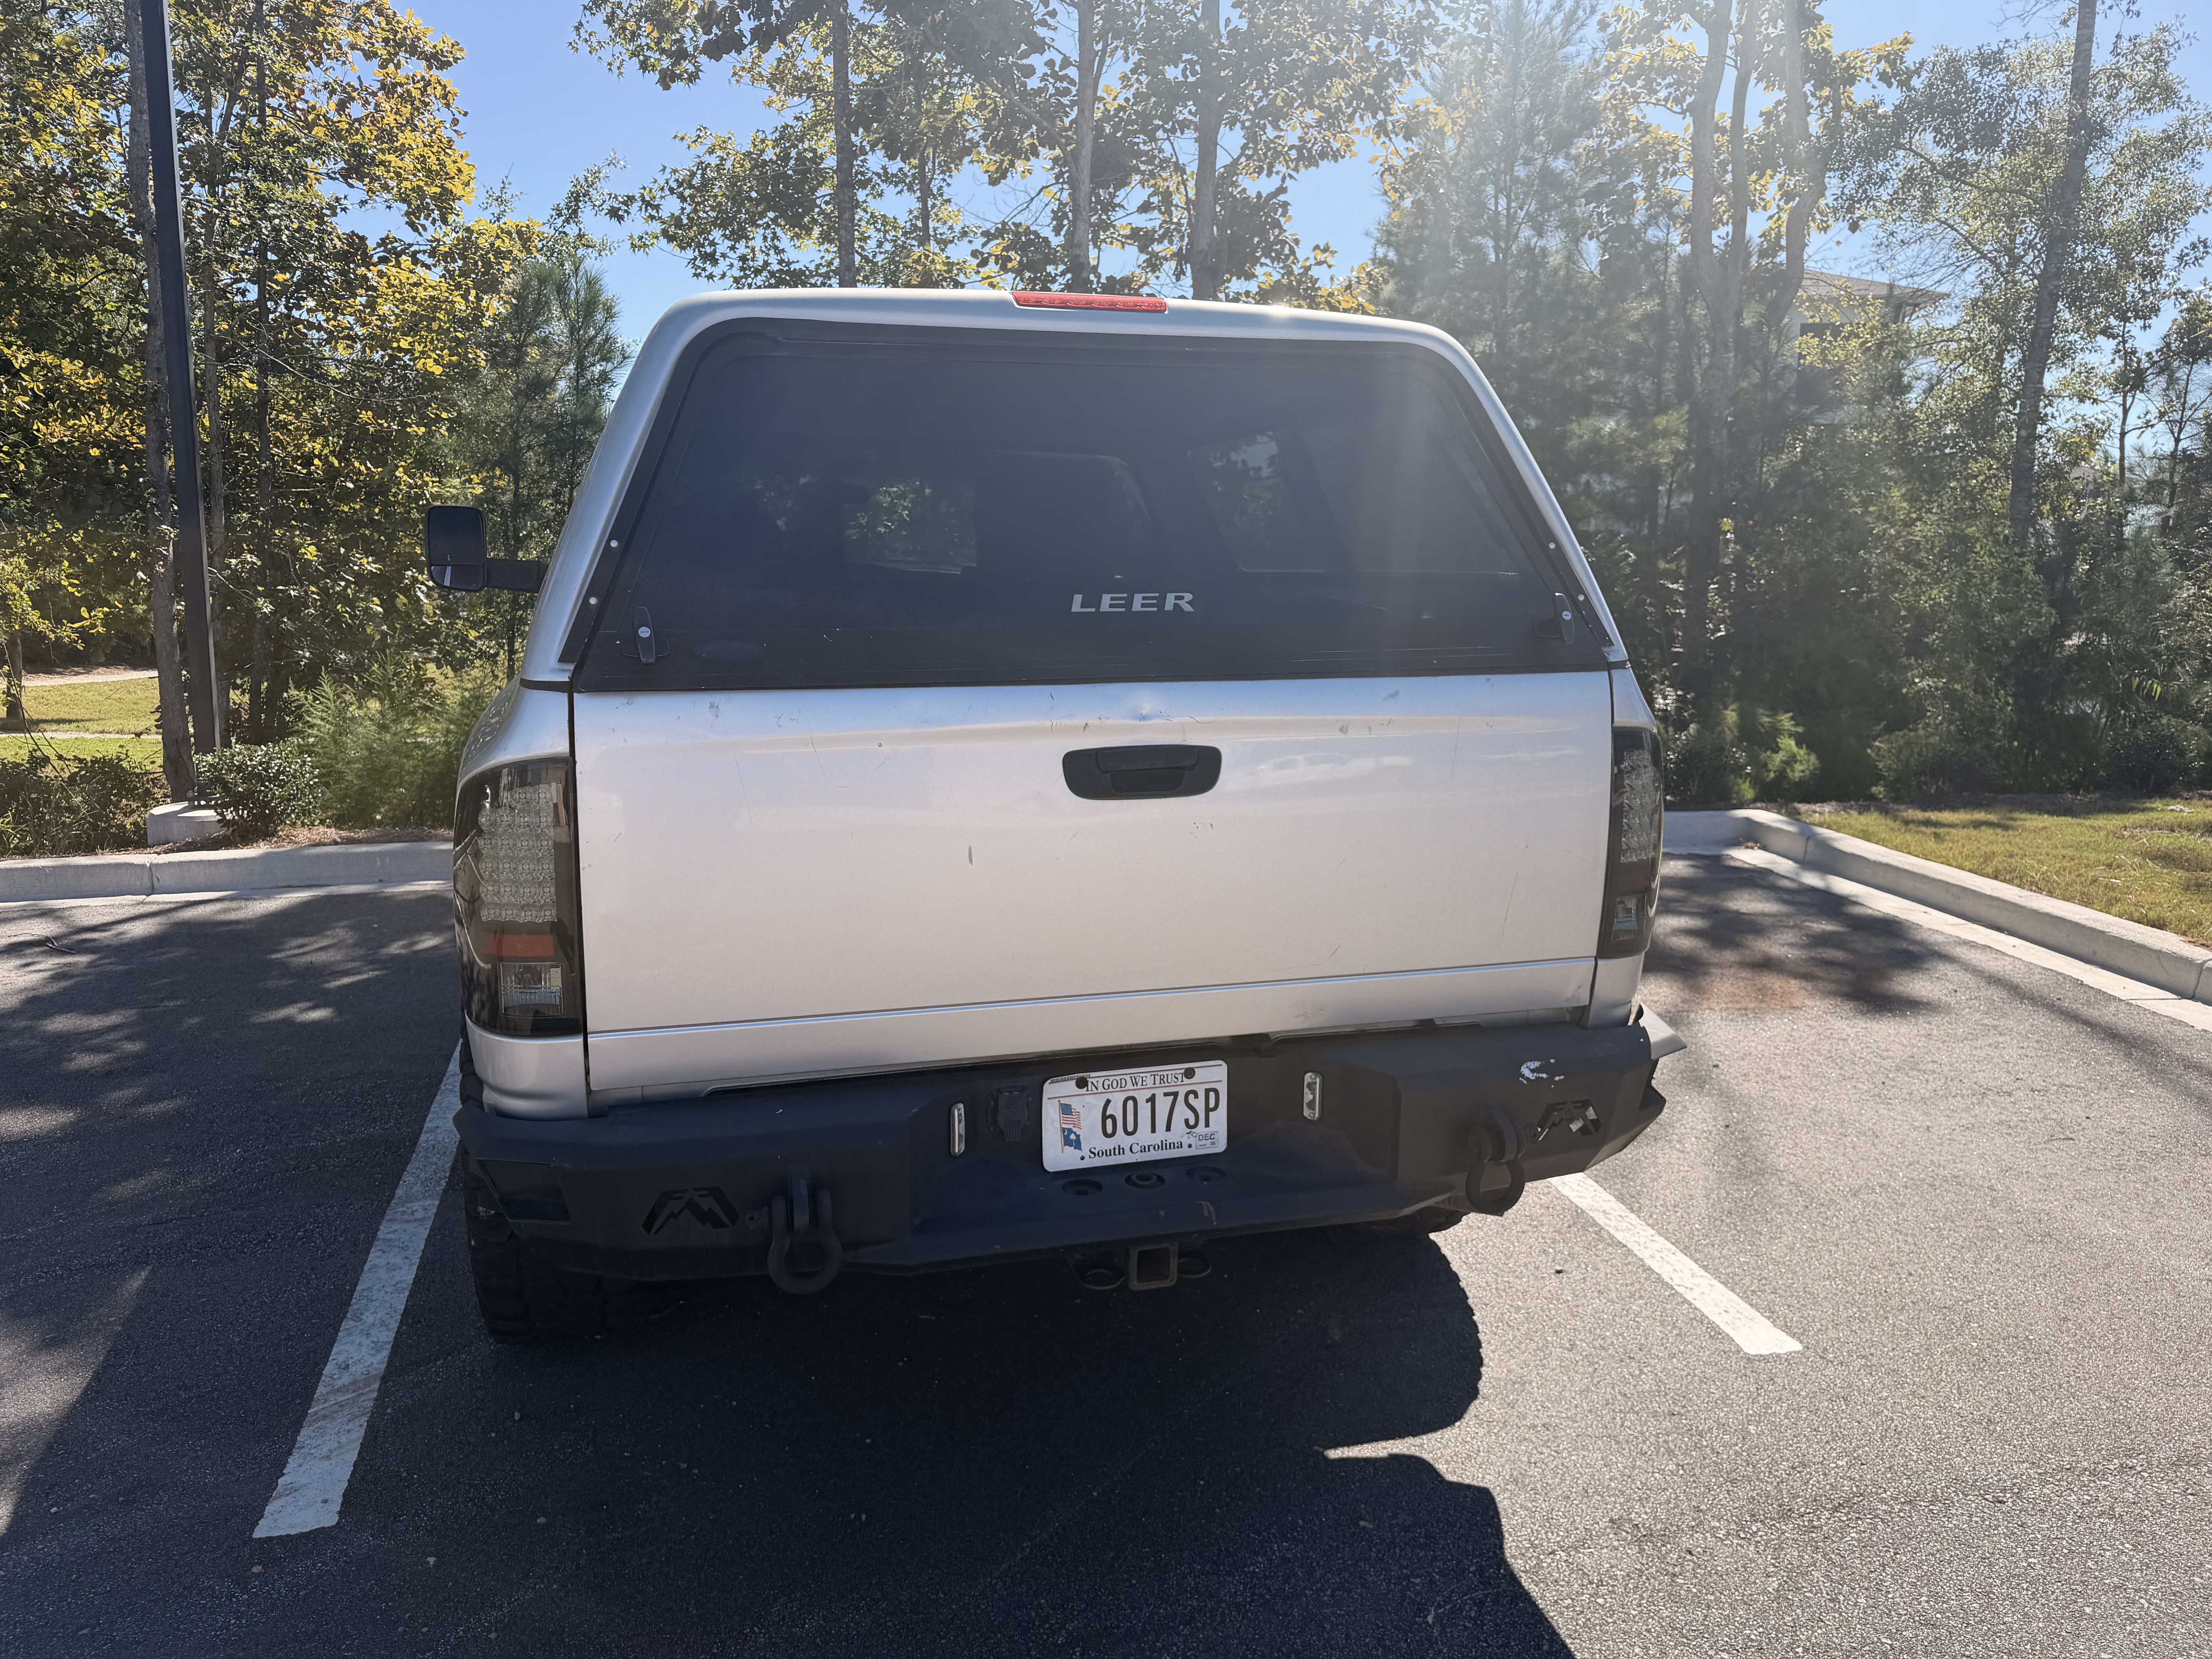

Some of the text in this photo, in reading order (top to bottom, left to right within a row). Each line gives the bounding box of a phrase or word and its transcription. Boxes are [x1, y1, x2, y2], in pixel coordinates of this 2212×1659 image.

[1071, 593, 1194, 612] LEER
[1085, 1079, 1099, 1092] IN
[1102, 1077, 1127, 1090] GOD
[1130, 1075, 1147, 1087] WE
[1150, 1072, 1185, 1085] TRUST
[1101, 1087, 1220, 1138] 6017SP
[1089, 1140, 1183, 1158] South Carolina
